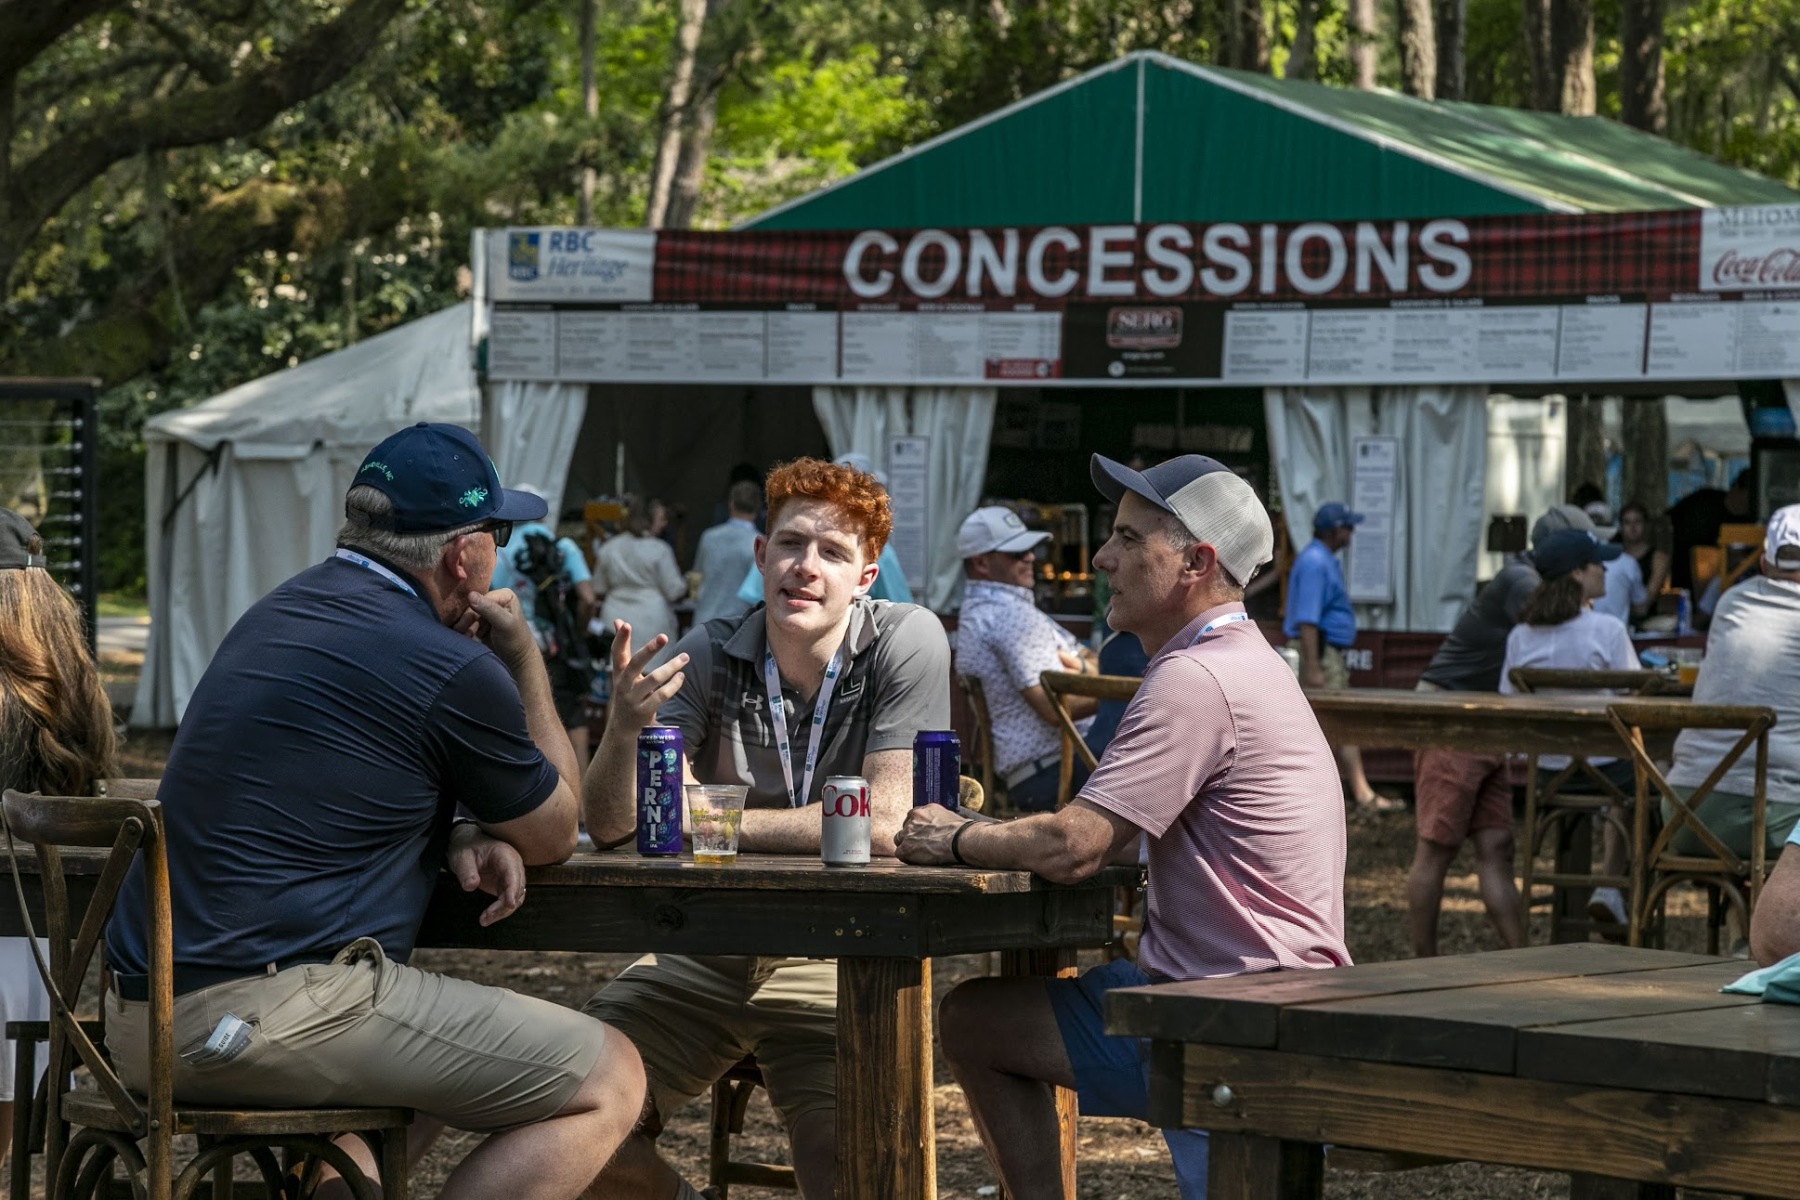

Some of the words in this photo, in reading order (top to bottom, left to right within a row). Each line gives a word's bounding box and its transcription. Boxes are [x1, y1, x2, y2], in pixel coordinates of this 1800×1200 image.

[549, 231, 597, 252] RBC
[547, 256, 629, 282] Heritage
[842, 221, 1473, 299] CONCESSIONS
[1343, 648, 1373, 670] RE
[218, 1032, 231, 1048] GUIDE
